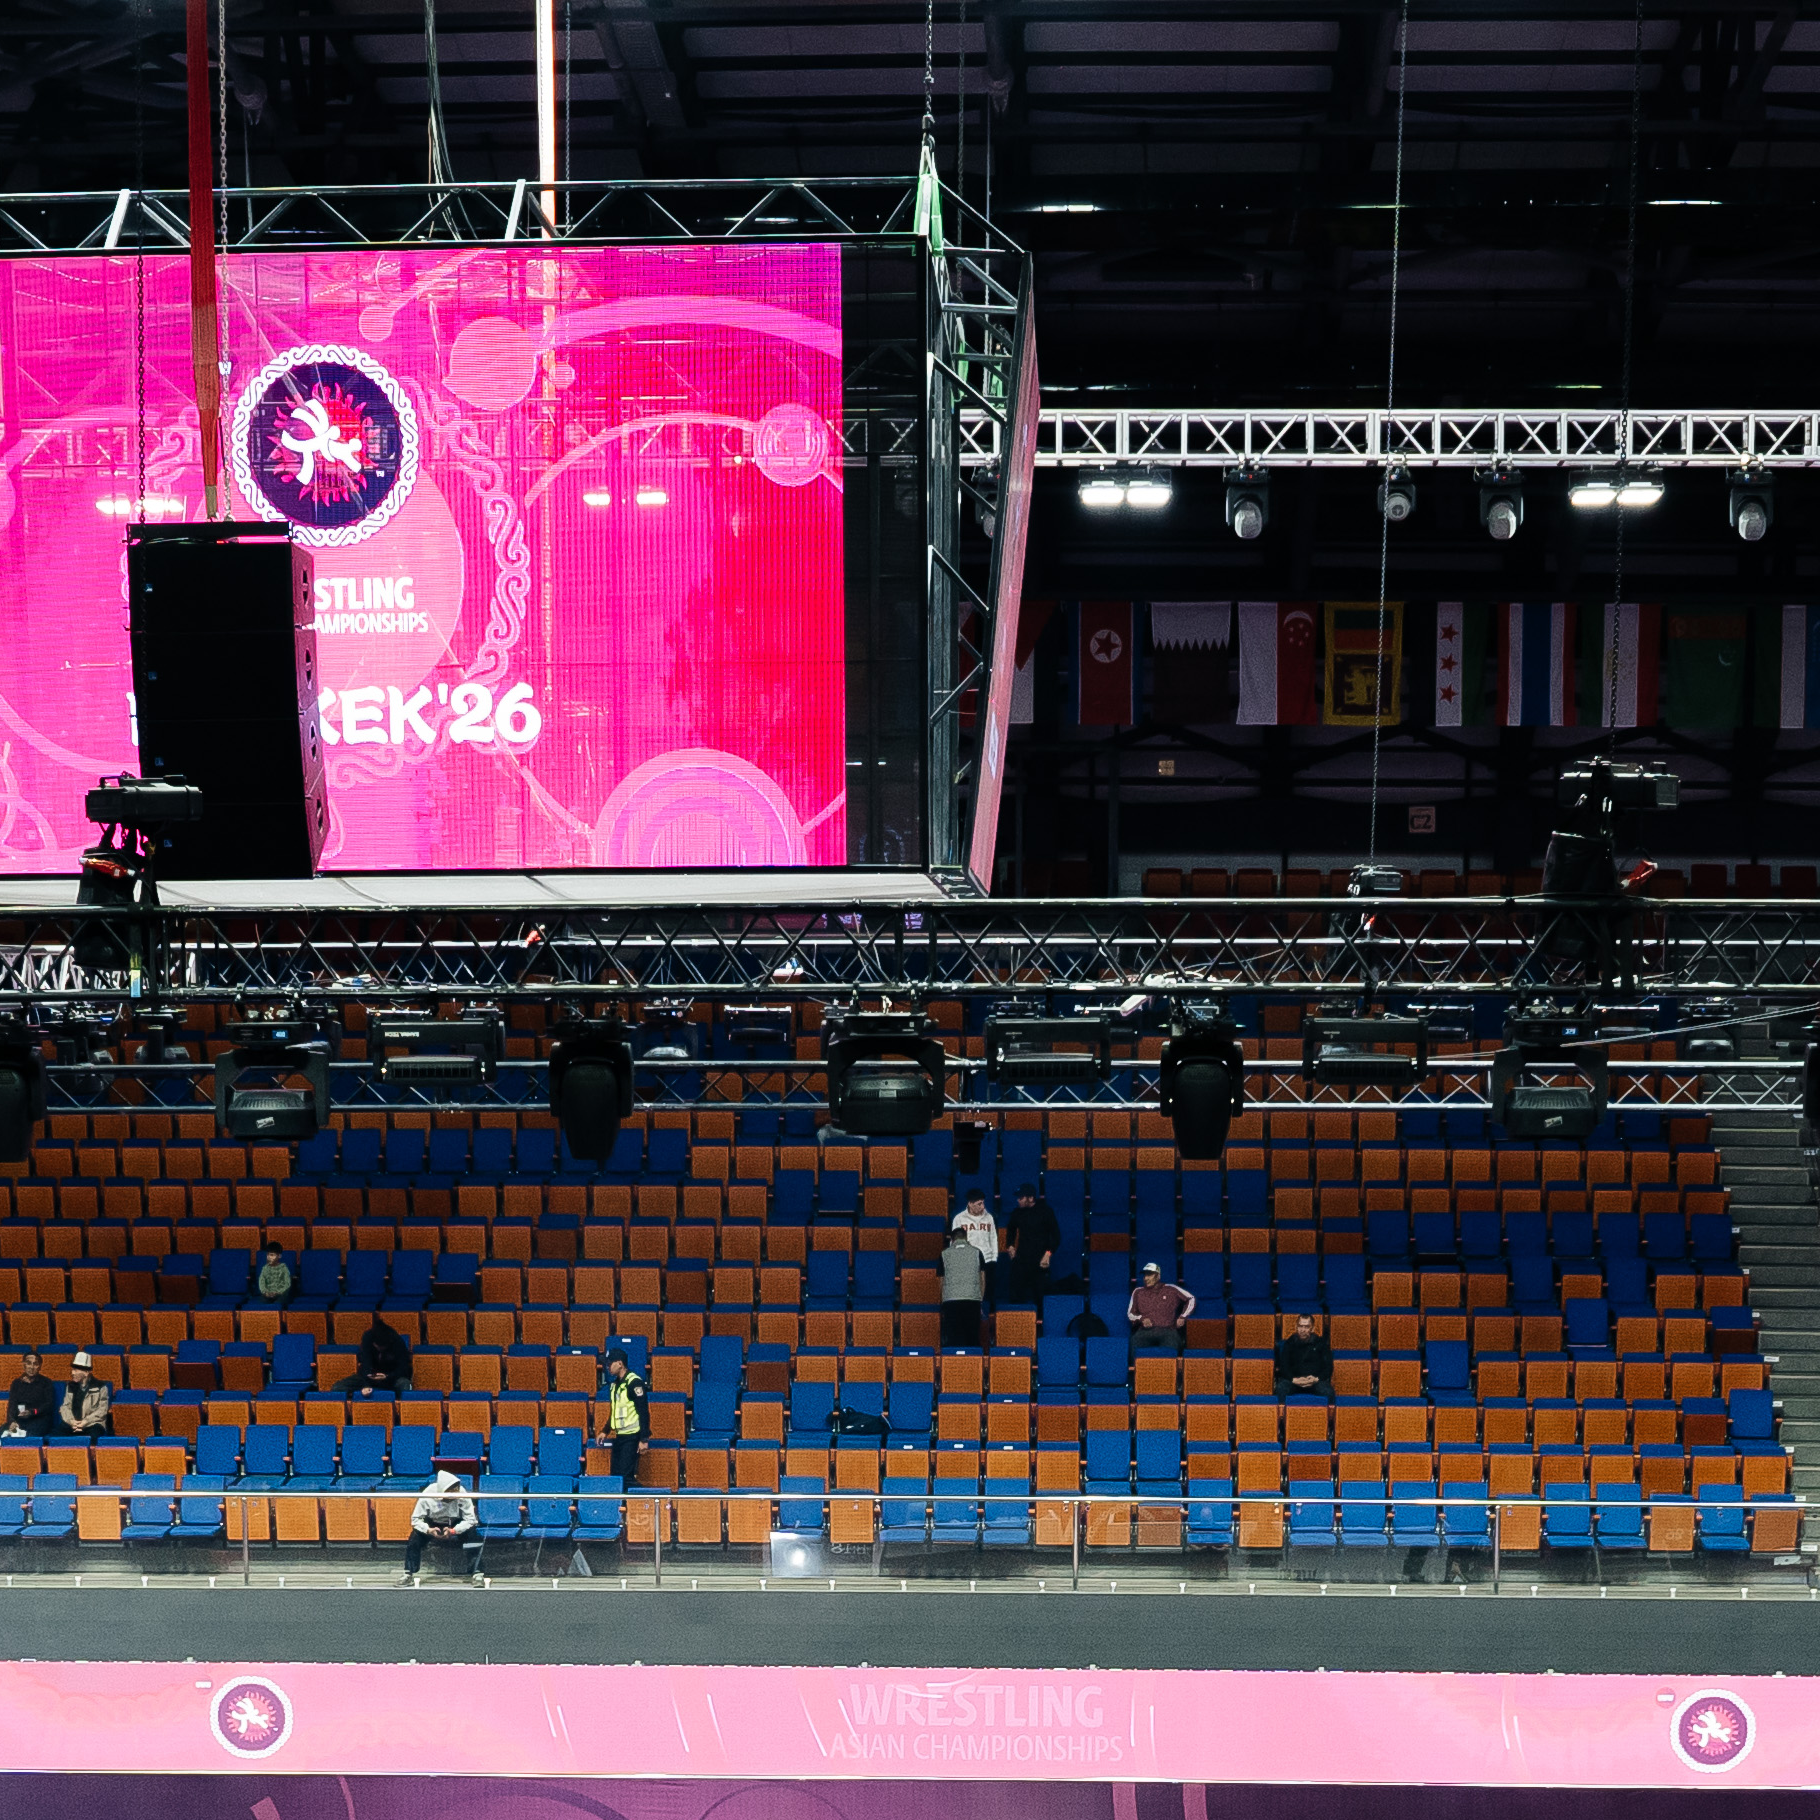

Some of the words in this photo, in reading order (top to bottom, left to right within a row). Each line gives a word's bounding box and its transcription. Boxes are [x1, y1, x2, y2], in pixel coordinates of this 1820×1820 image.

[314, 577, 415, 610] STLING
[315, 613, 428, 633] AMPIONSHIPS
[318, 682, 542, 745] KEK'26
[851, 1683, 1103, 1728] WRESTLING
[827, 1734, 901, 1760] ASIAN
[906, 1734, 1123, 1763] CHAMPIONSHIPS
